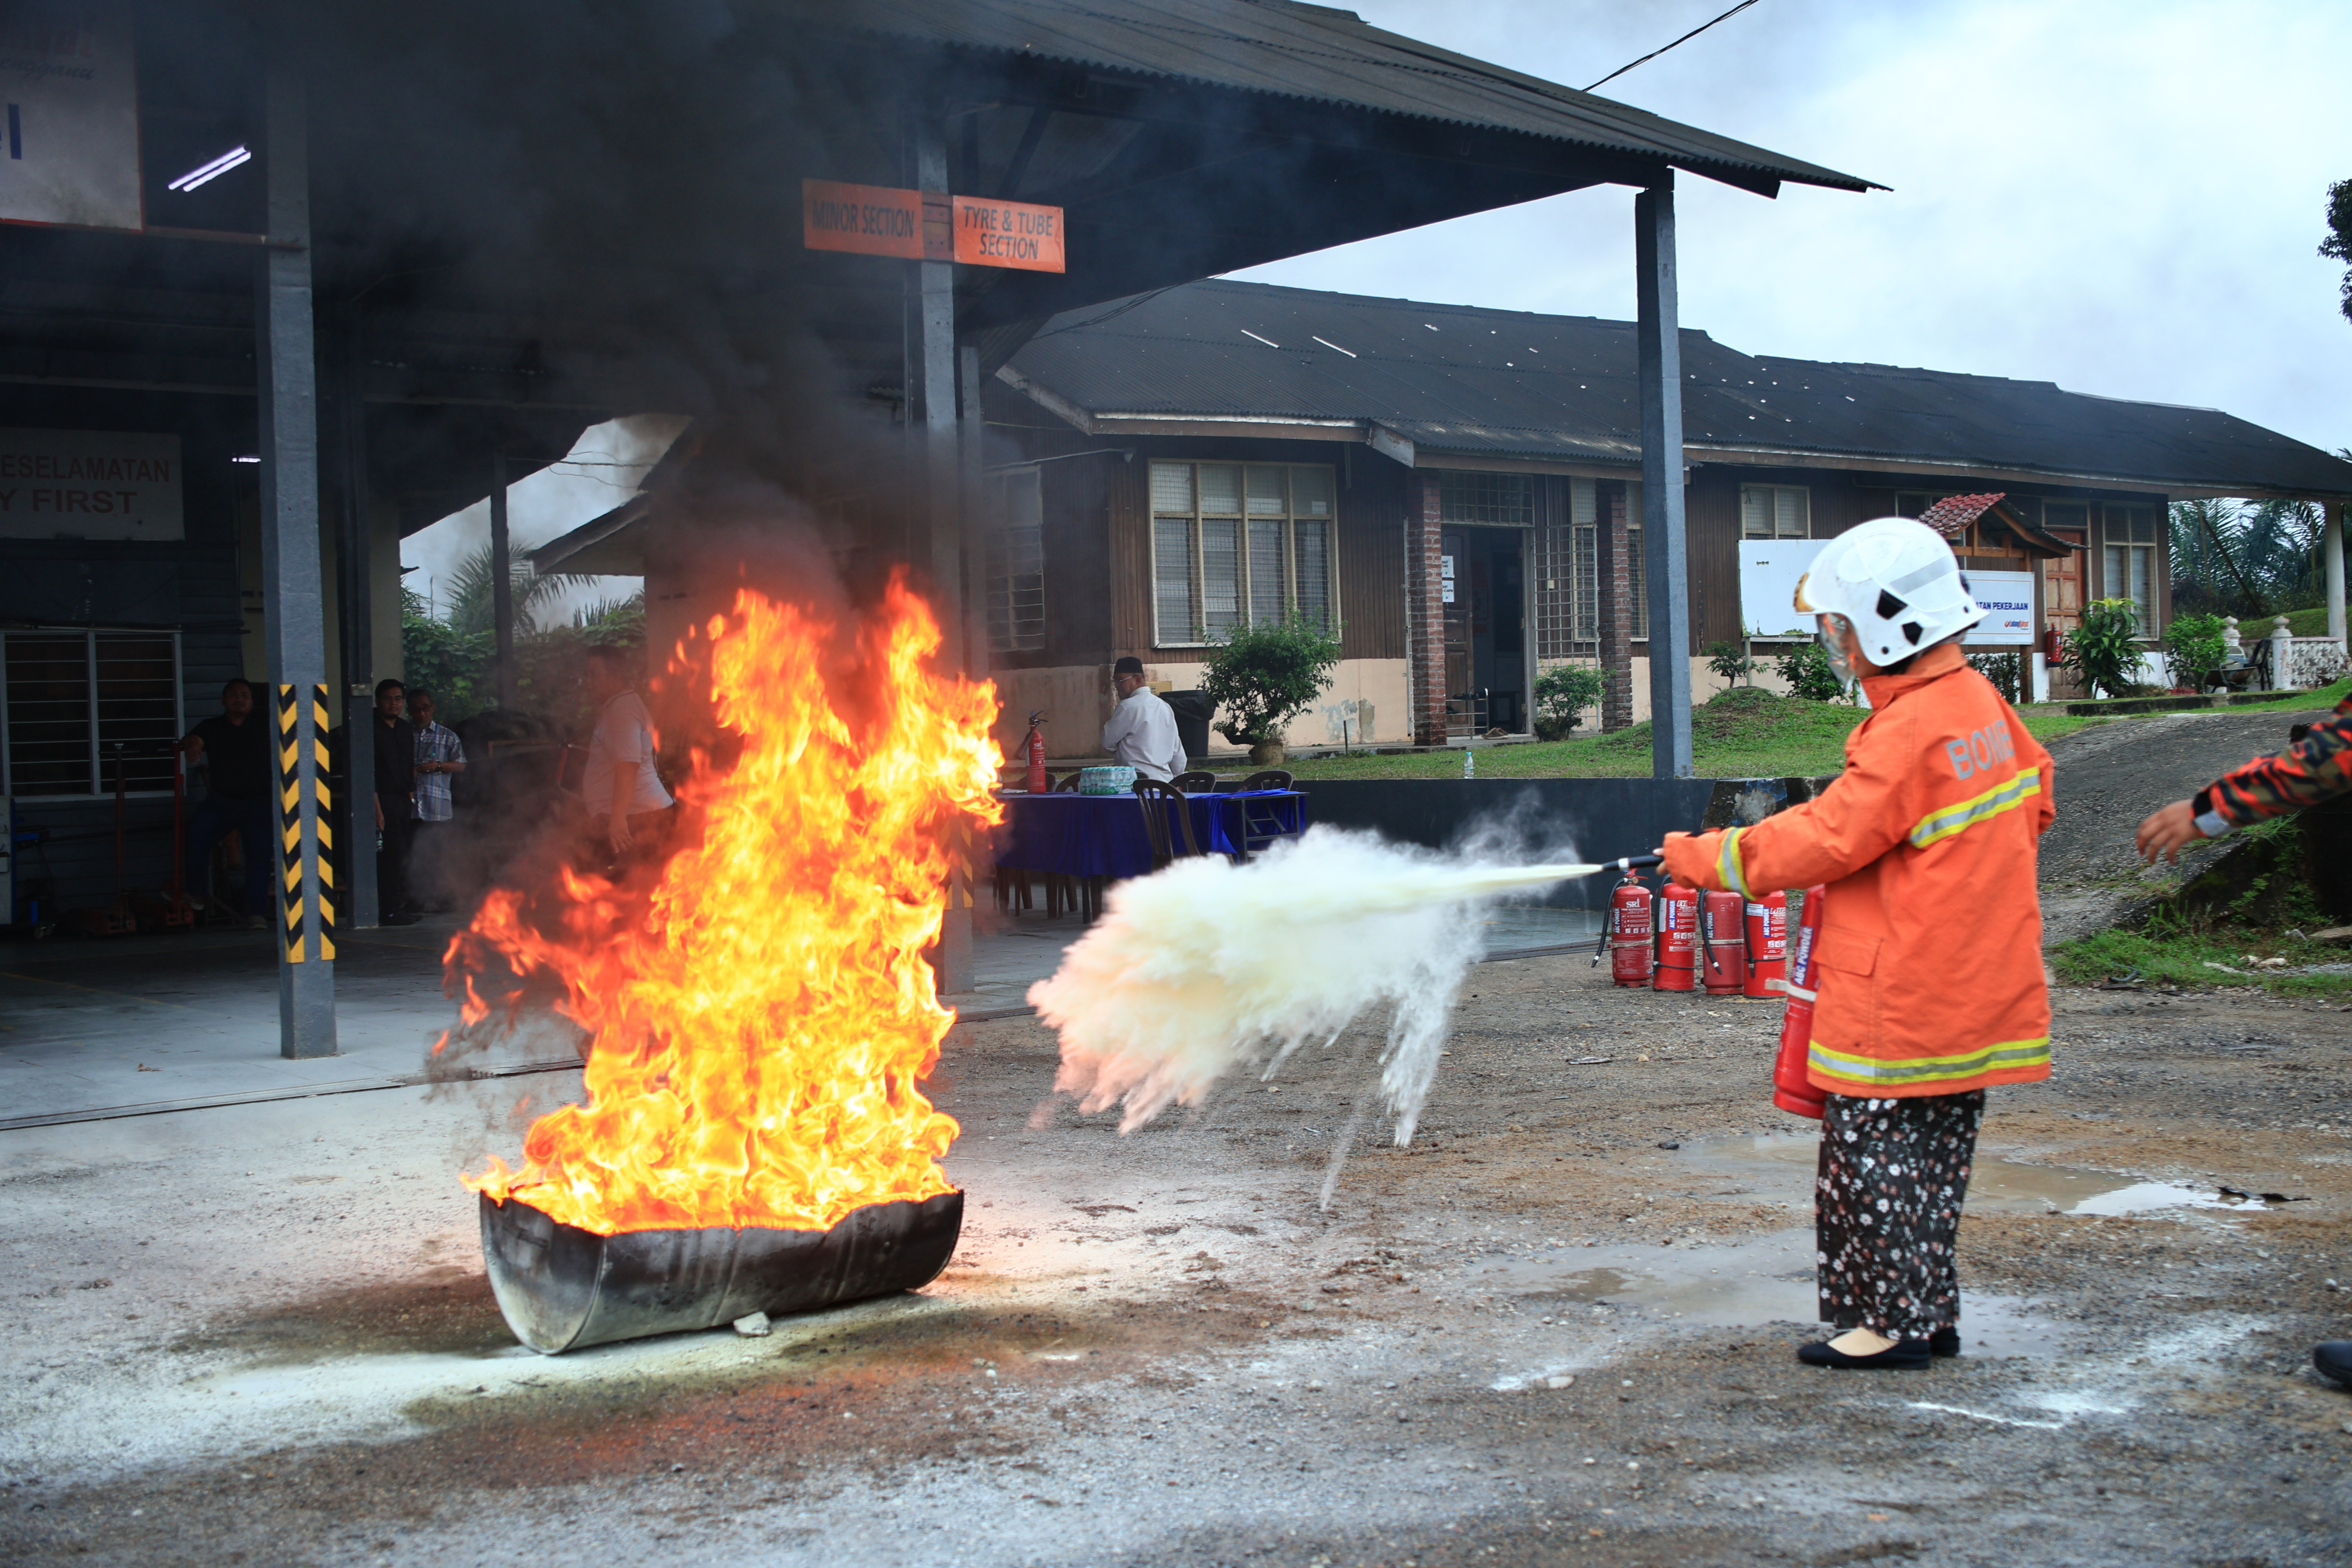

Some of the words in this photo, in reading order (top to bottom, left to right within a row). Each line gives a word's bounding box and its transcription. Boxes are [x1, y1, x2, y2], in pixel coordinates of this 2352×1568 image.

[813, 199, 858, 232] MINOR
[862, 205, 914, 238] SECTION
[964, 206, 998, 230] TYRE
[1002, 210, 1013, 232] &
[1018, 212, 1054, 236] TUBE
[980, 233, 1038, 260] SECTION
[1, 454, 170, 482] ESELAMATAN
[0, 488, 18, 511] Y
[33, 489, 137, 514] FIRST
[1993, 602, 2028, 610] PEKERJAAN
[1626, 898, 1640, 907] SRI
[1797, 927, 1813, 964] POWDER
[1794, 965, 1806, 985] ABC
